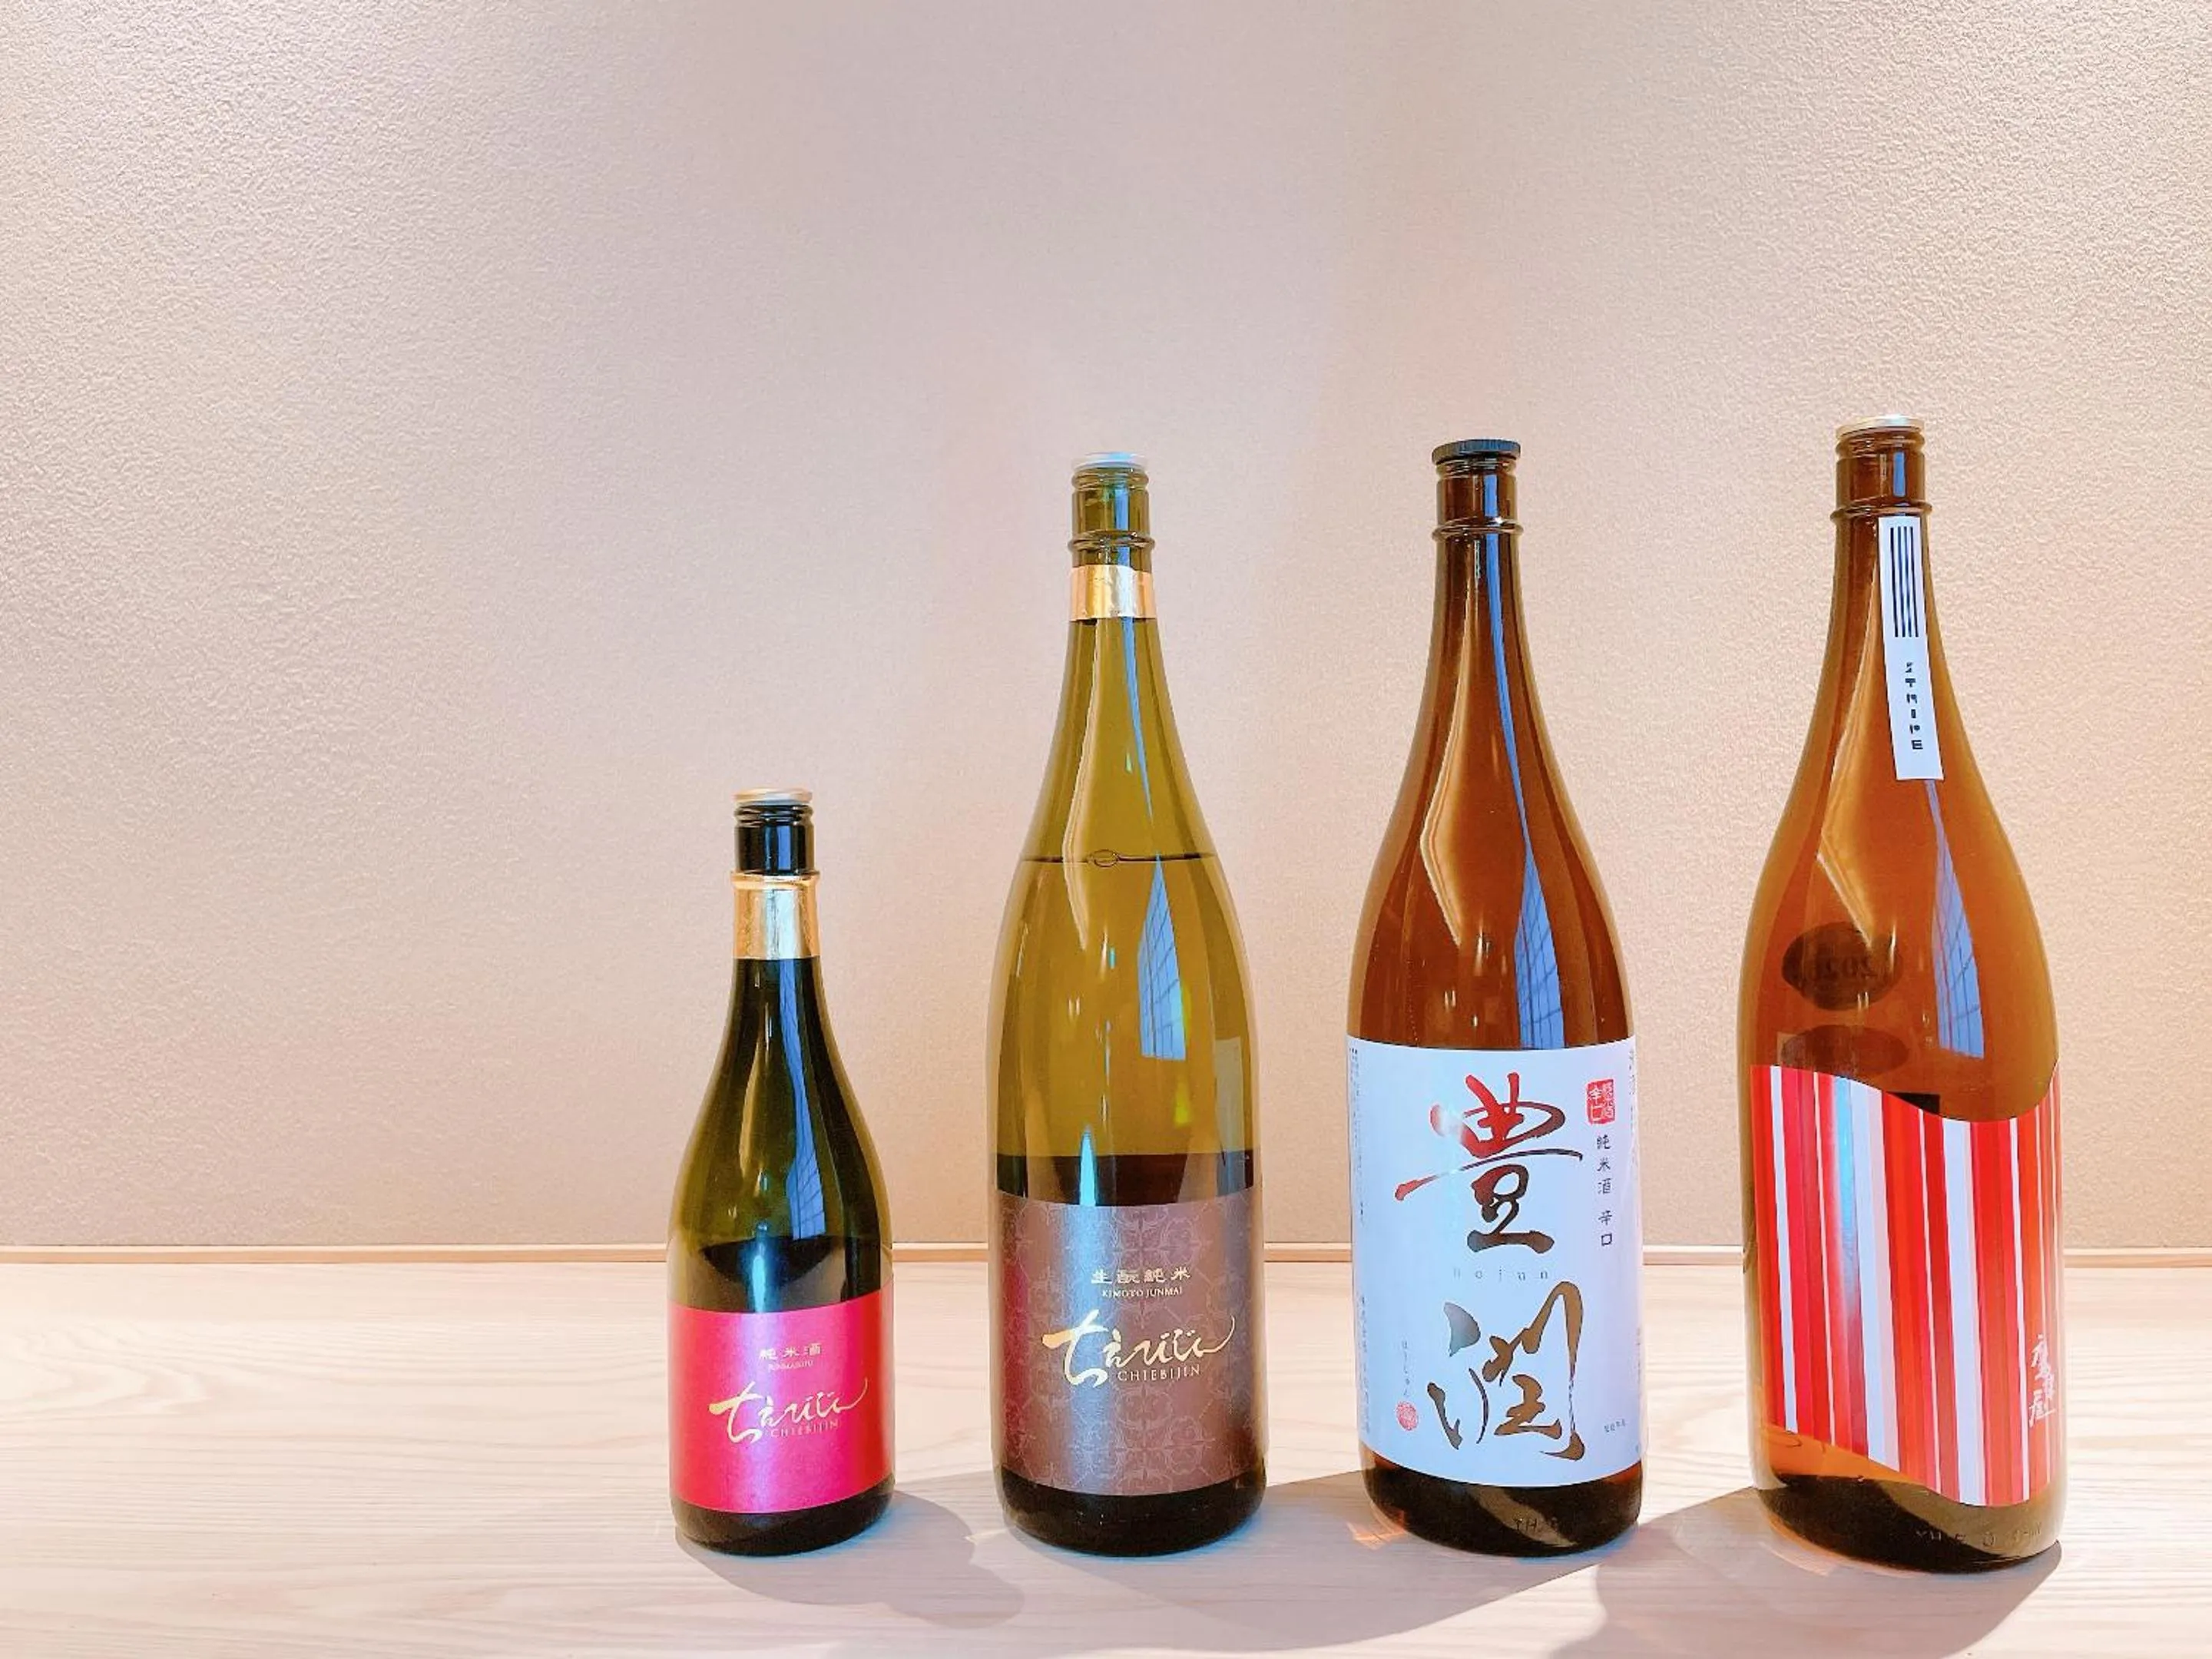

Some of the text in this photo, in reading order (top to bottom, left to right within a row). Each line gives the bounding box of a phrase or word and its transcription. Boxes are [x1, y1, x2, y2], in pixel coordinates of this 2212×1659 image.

[1596, 1134, 1612, 1195] 純米酒
[1598, 1210, 1614, 1247] 辛口
[1101, 1286, 1184, 1299] KIMOTO JUNMAI
[1118, 1363, 1200, 1382] CHIEBIJIN
